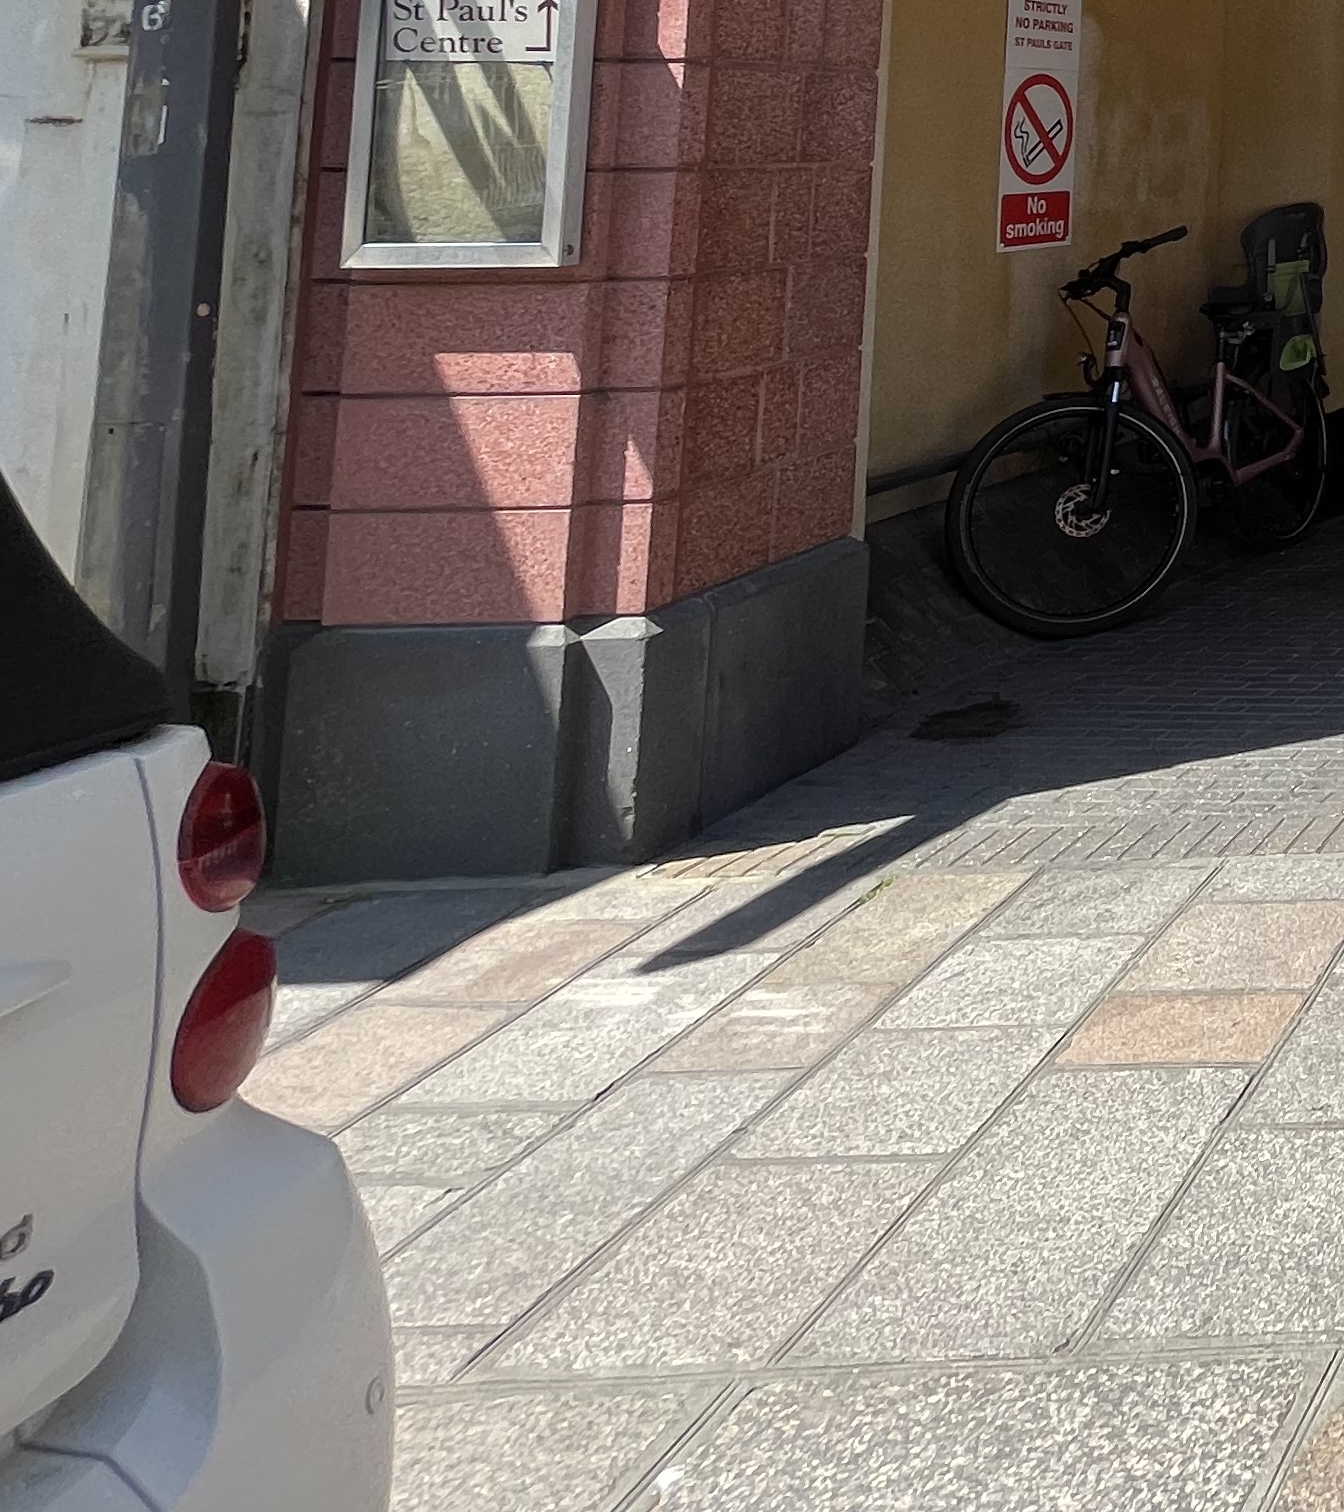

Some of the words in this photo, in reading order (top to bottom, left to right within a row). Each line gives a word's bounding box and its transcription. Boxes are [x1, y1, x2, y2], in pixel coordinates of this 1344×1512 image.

[1023, 0, 1068, 16] STRICTLY
[1015, 16, 1030, 30] NO
[1032, 18, 1074, 34] PARKING
[392, 27, 505, 54] Centre
[1014, 36, 1025, 47] ST
[1027, 37, 1052, 50] PAULS
[1053, 40, 1073, 52] GATE
[1026, 195, 1047, 215] No
[1005, 218, 1065, 240] smoking
